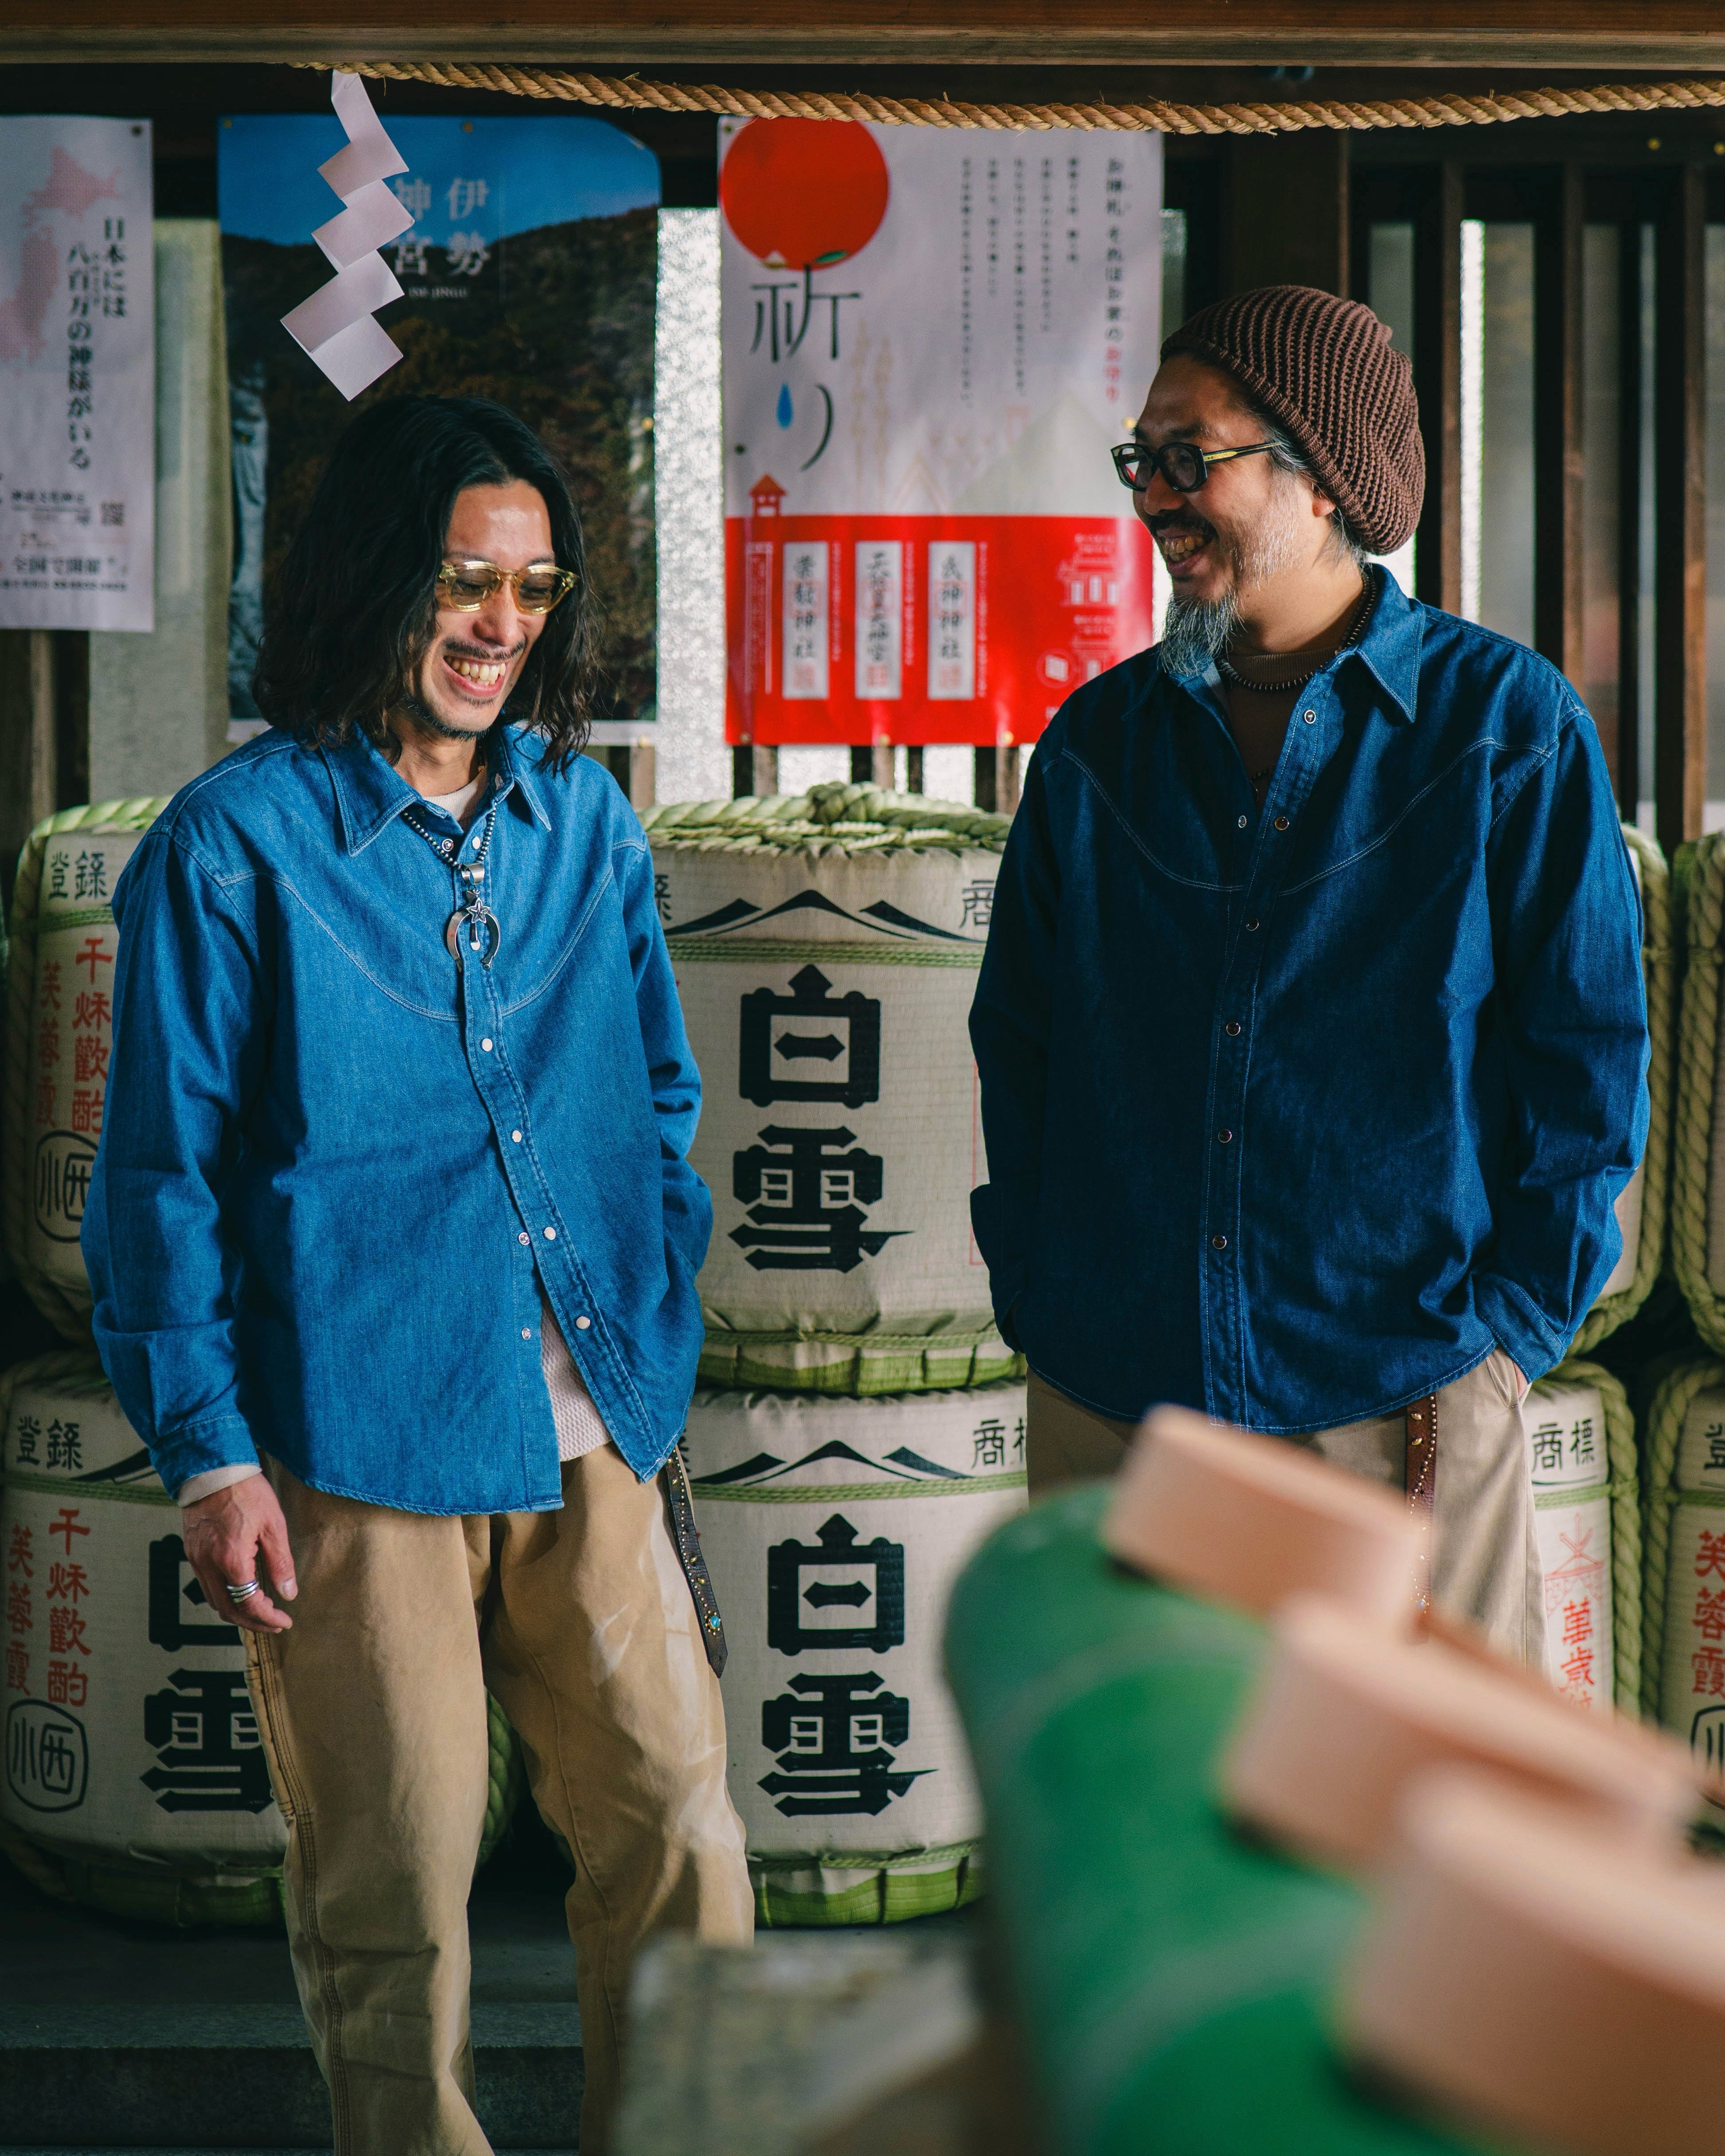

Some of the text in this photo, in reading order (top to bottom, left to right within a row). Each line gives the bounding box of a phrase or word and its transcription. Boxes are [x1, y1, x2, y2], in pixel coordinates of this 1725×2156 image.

[390, 177, 433, 276] 神宮
[445, 177, 491, 276] 伊勢
[750, 265, 861, 471] 祈り
[729, 964, 914, 1274] 白雪
[1532, 1418, 1595, 1473] 商標
[757, 1513, 939, 1817] 白雪
